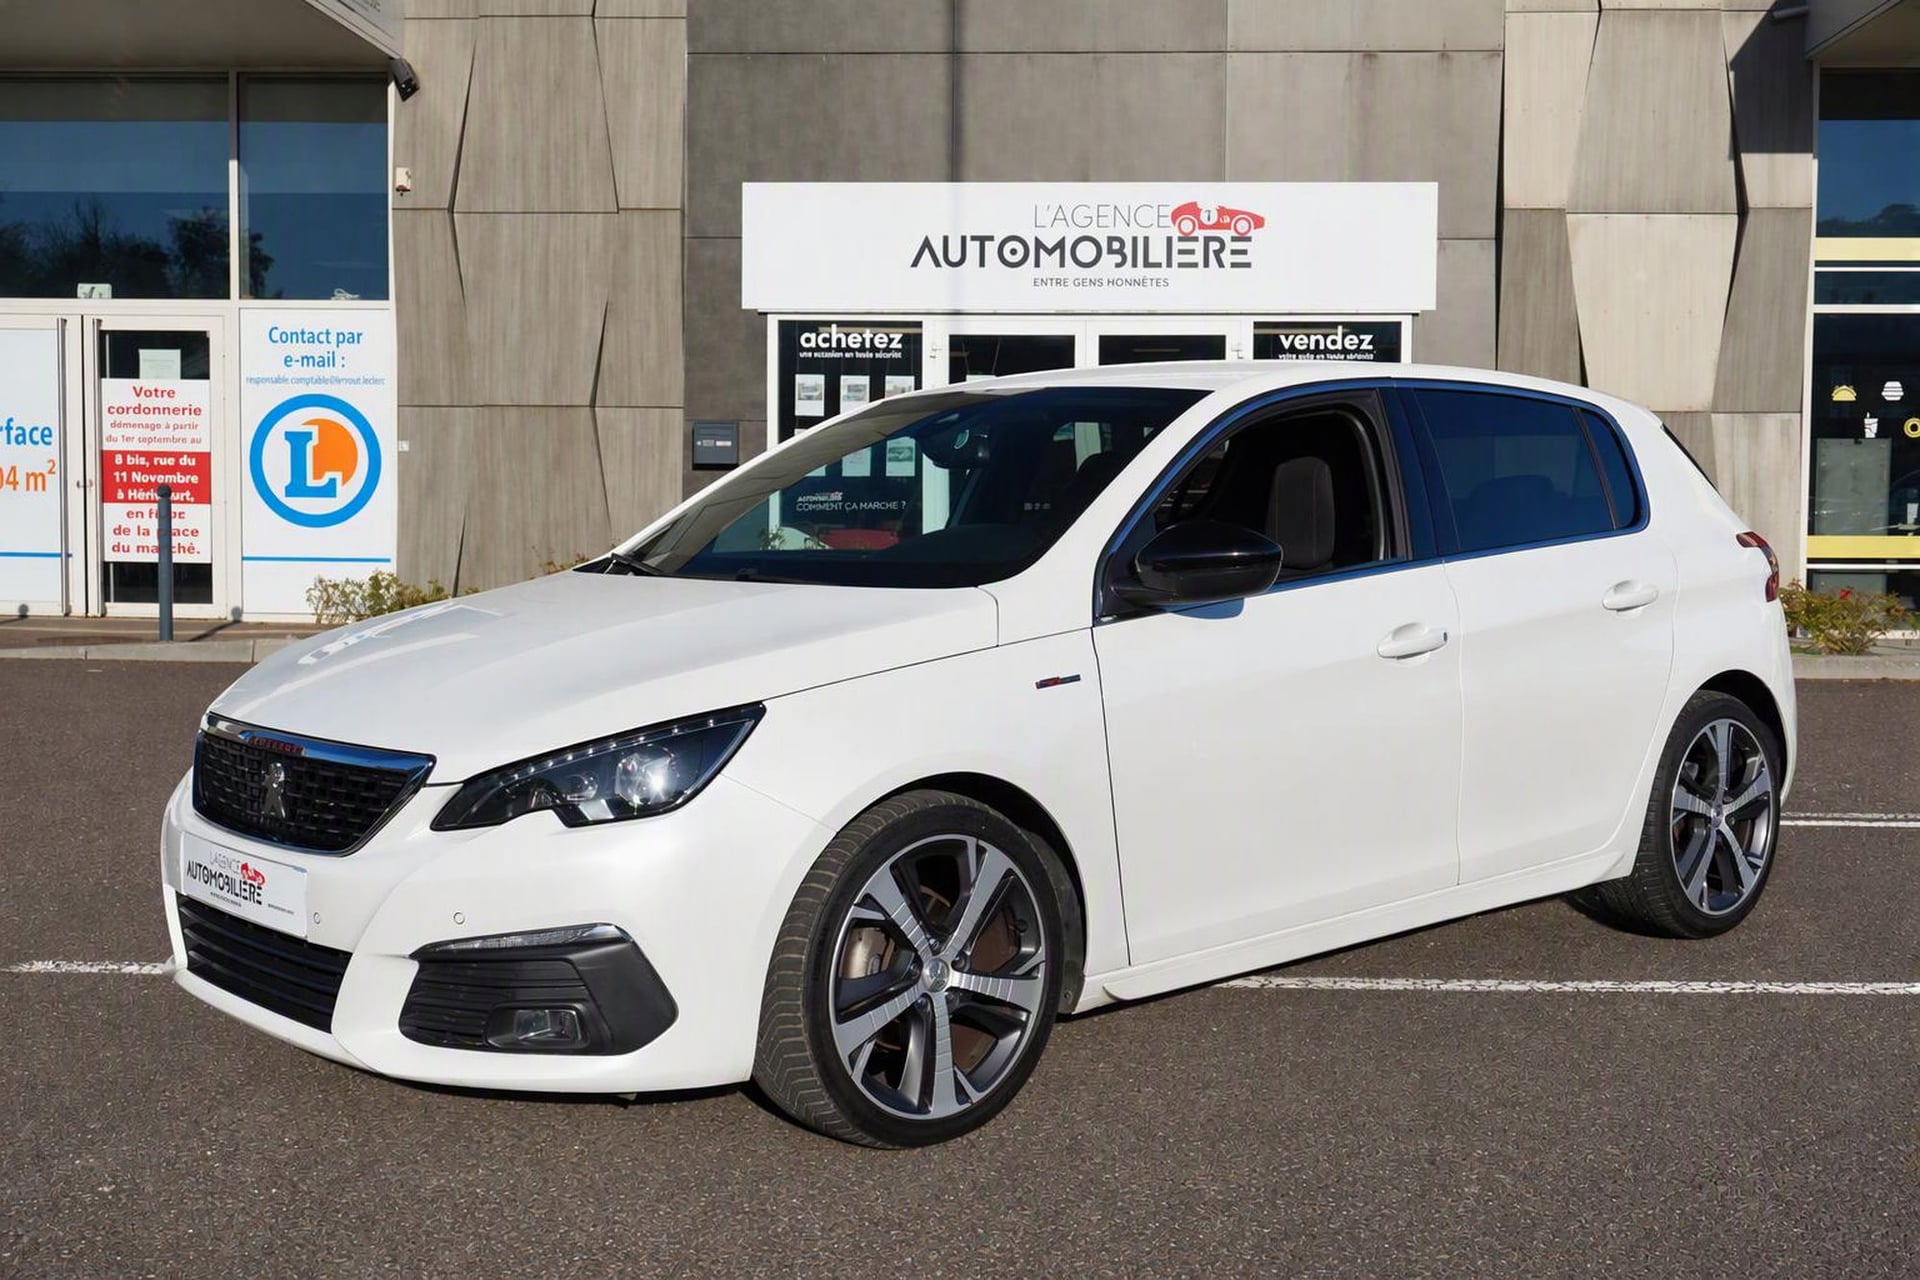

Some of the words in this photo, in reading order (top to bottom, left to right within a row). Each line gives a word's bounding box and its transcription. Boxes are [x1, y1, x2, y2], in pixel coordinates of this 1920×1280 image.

[1034, 203, 1171, 229] L'AGENCE
[1033, 278, 1069, 288] ENTRE
[1073, 278, 1104, 288] GENS
[1106, 275, 1170, 288] HONNÊTES
[268, 326, 332, 344] Contact
[336, 331, 363, 348] par
[799, 323, 903, 349] achetez
[1279, 325, 1374, 350] vendez
[283, 350, 336, 368] e-mail
[132, 385, 176, 398] Votre
[107, 403, 202, 416] cordonnerie
[172, 421, 199, 431] partir
[105, 434, 118, 443] du
[137, 435, 188, 445] septembre
[114, 454, 123, 465] 8
[126, 454, 150, 468] bis,
[153, 457, 176, 466] rue
[179, 454, 196, 466] du
[113, 471, 128, 483] 11
[131, 471, 199, 484] Novembre
[116, 488, 125, 500] à
[796, 502, 842, 511] COMMENT
[844, 502, 858, 513] ÇA
[859, 501, 899, 510] MARCHE
[901, 501, 907, 510] ?
[126, 509, 144, 519] en
[113, 524, 131, 536] de
[137, 525, 150, 536] la
[112, 541, 130, 553] du
